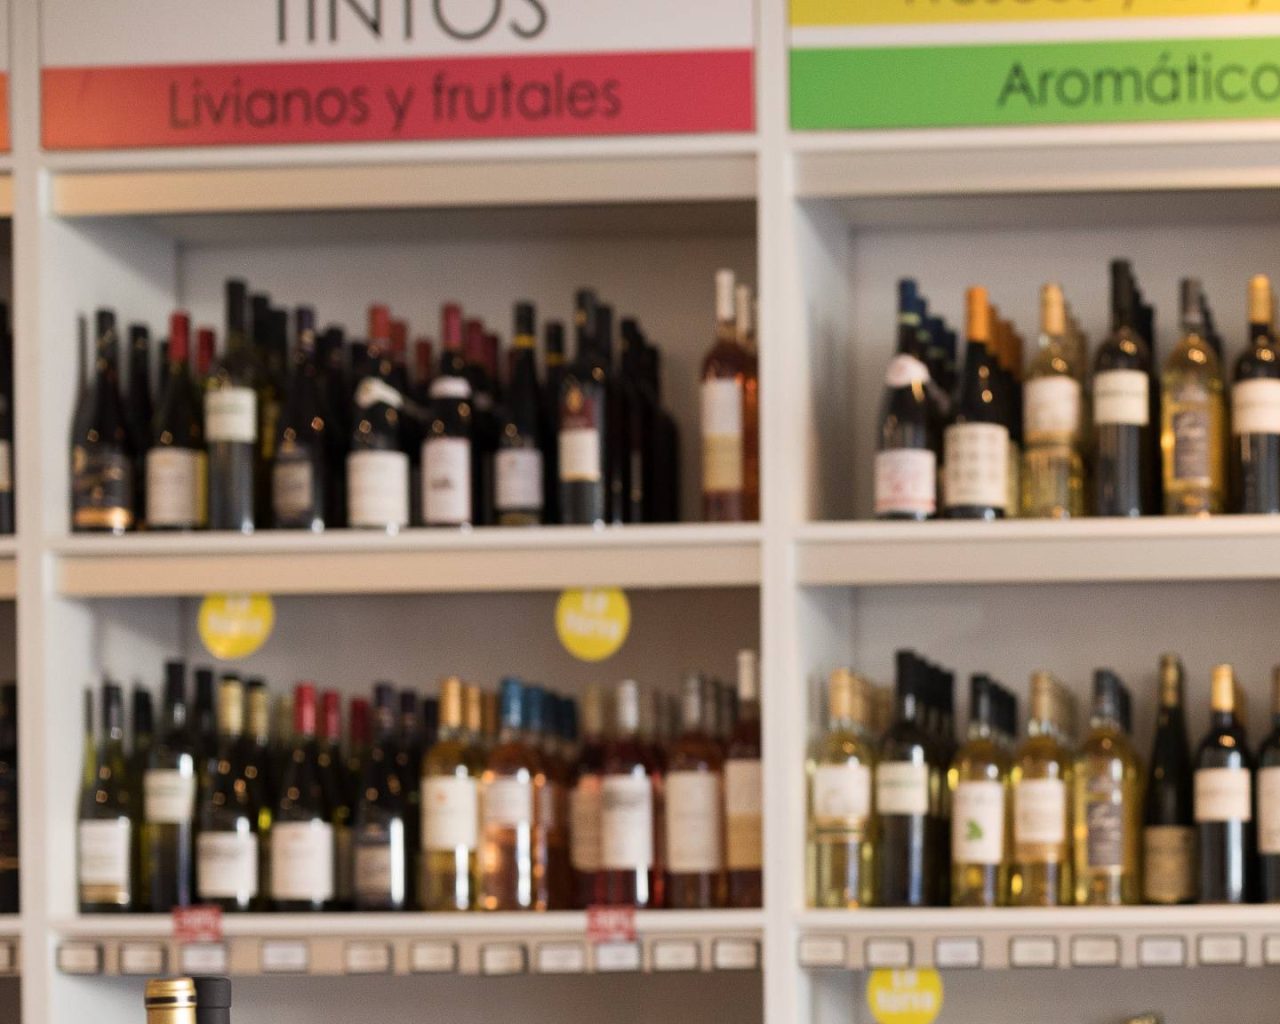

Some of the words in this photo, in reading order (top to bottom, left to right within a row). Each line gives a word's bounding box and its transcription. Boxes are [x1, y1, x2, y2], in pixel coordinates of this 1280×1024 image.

[167, 80, 370, 130] Livianos
[386, 82, 413, 131] y
[431, 69, 622, 122] frutales
